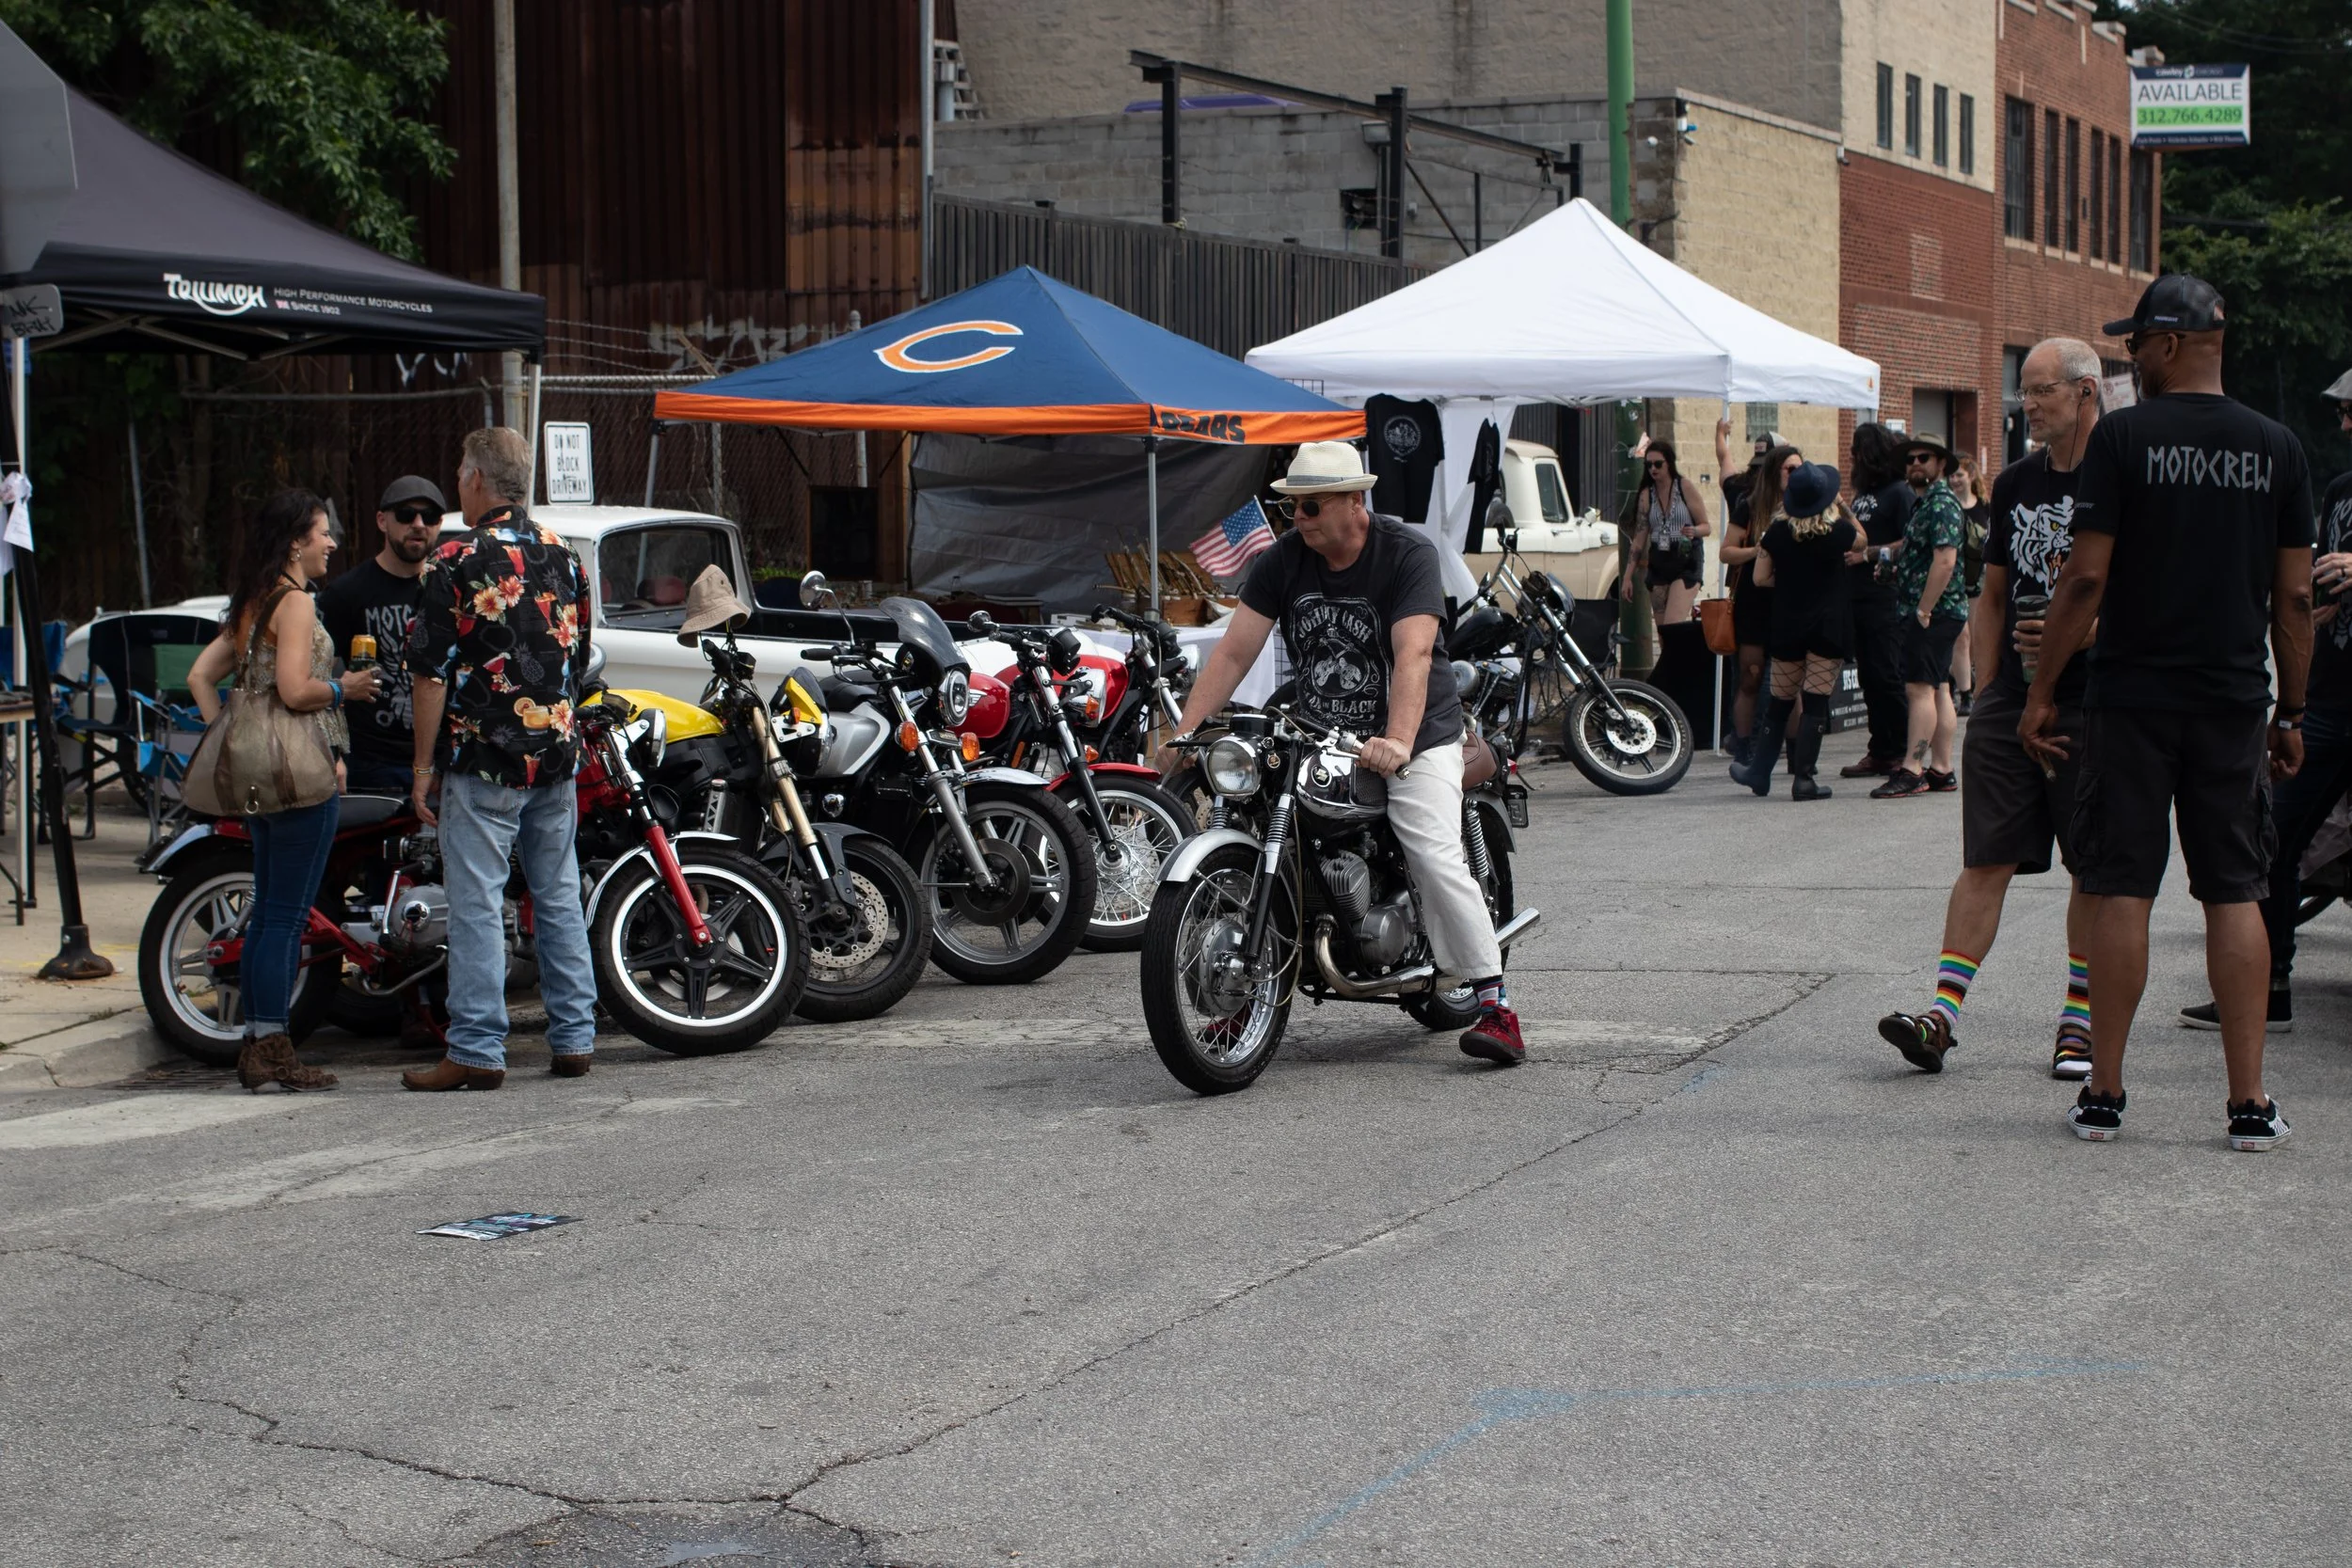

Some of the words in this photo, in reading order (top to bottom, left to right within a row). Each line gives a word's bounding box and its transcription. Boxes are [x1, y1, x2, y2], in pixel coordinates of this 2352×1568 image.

[2137, 82, 2243, 102] AVAILABLE
[2137, 107, 2242, 123] 312.766.4289
[164, 273, 267, 315] TRIUMPH
[274, 287, 297, 297] HIGH
[299, 289, 365, 306] PERFORMANCE
[368, 297, 433, 313] MOTORCYCLES
[291, 301, 320, 312] SINCE
[322, 305, 341, 315] 1902
[873, 320, 1024, 372] C
[554, 435, 563, 449] DO
[566, 435, 580, 449] NOT
[557, 457, 580, 471] BLOCK
[2147, 445, 2273, 494] MOTOCREW
[552, 479, 587, 494] DRIVEWAY
[1298, 605, 1341, 639] JOHNNY
[1342, 610, 1374, 643] CASH
[1331, 699, 1377, 714] BLACK
